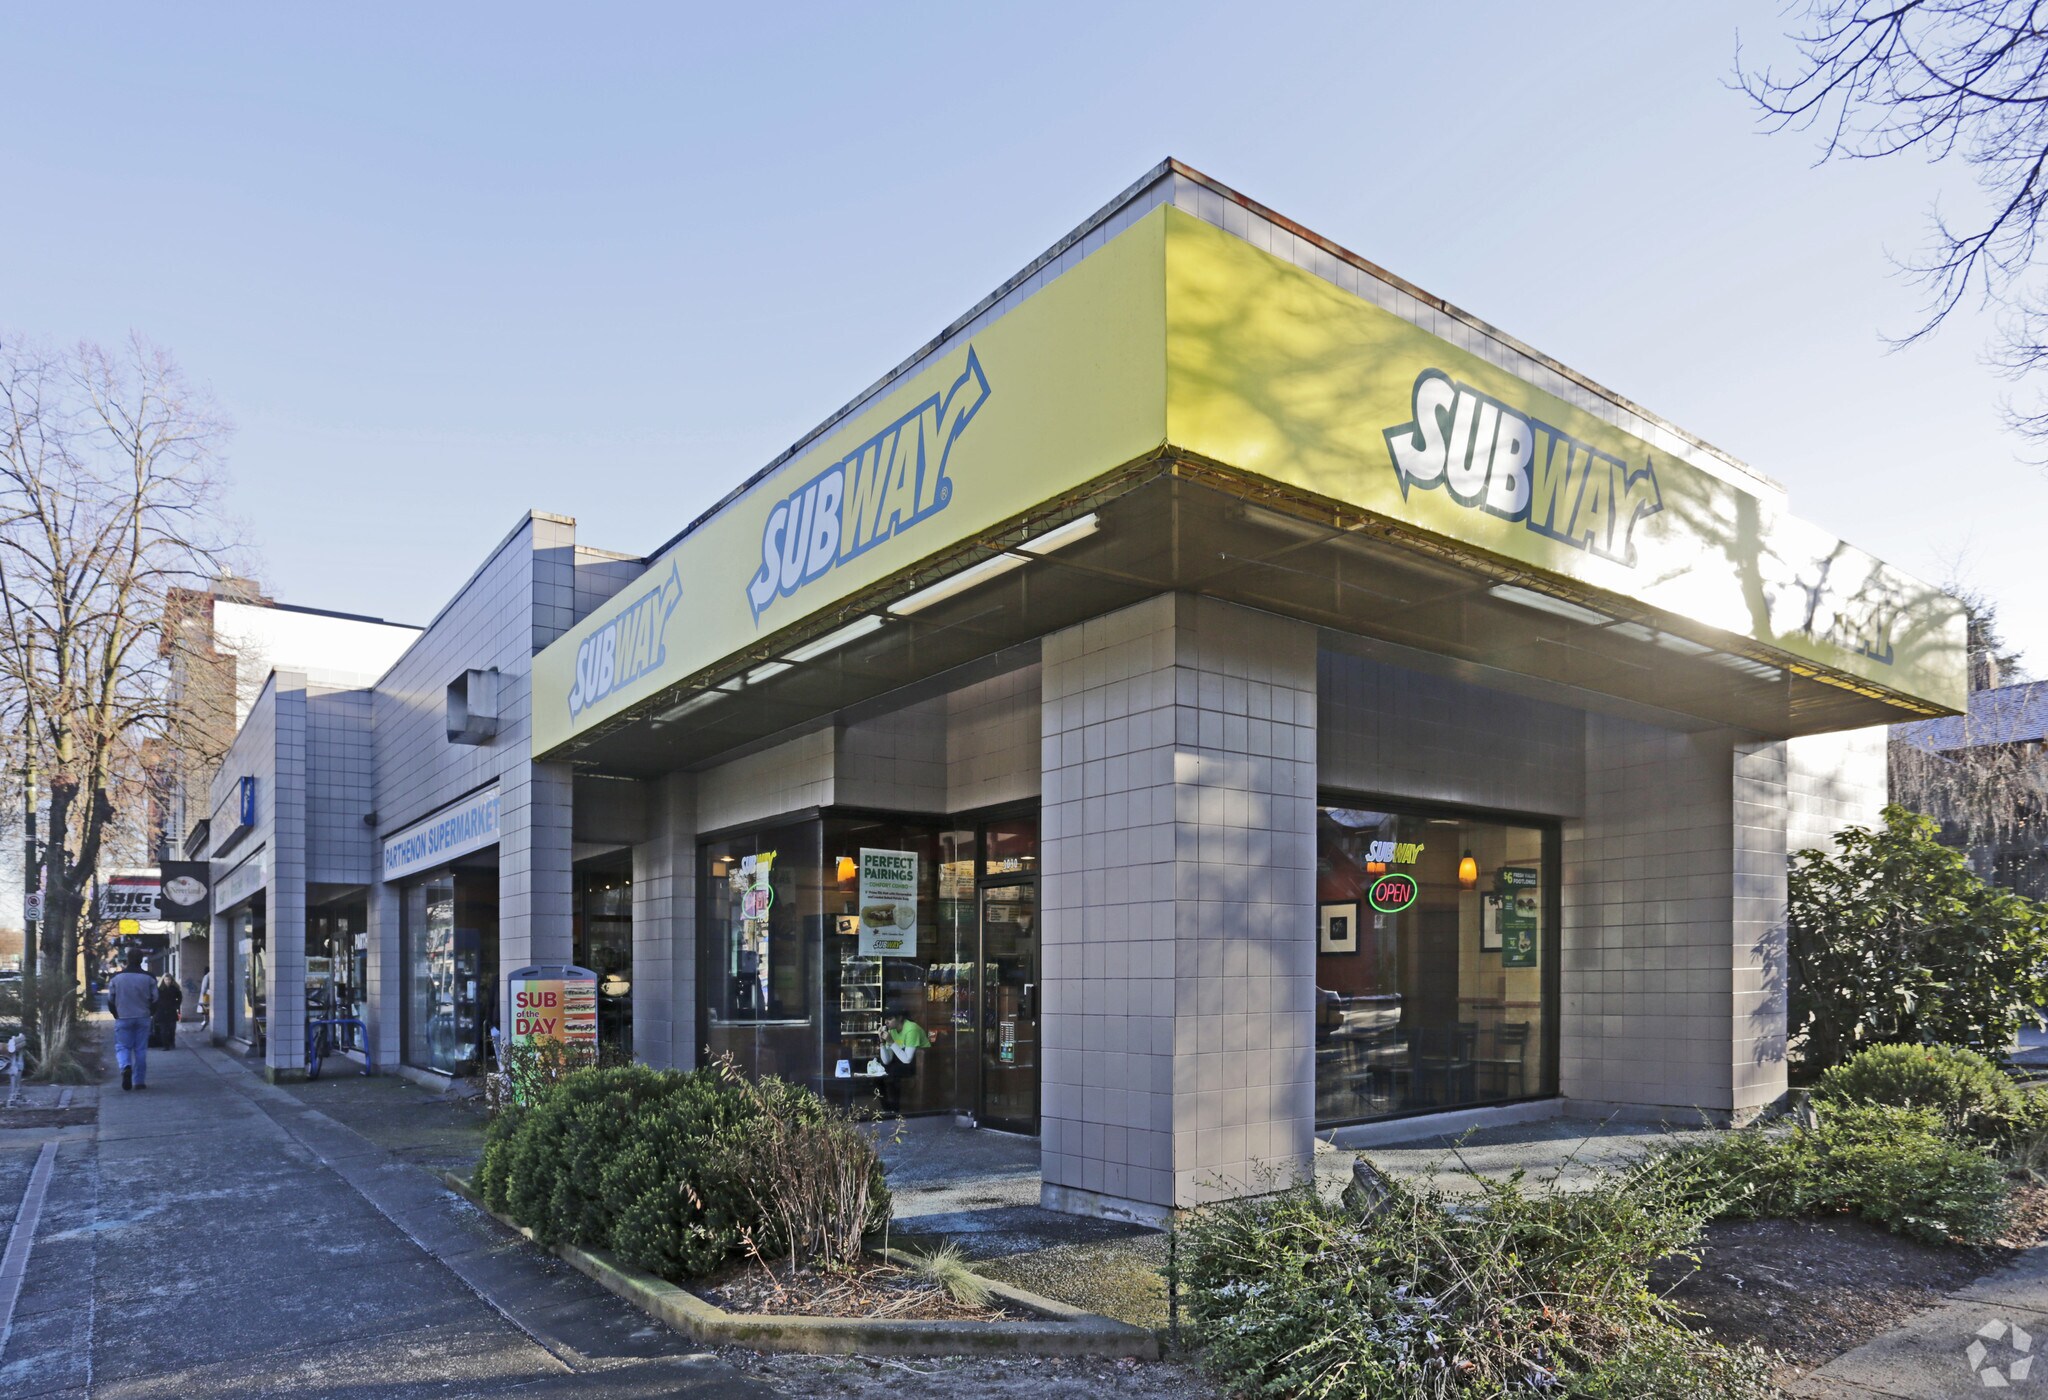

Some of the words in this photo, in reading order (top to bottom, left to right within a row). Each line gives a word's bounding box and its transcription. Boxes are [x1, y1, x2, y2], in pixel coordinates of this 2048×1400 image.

[1382, 367, 1664, 569] SUBWAY
[746, 343, 991, 630] SUBWAY
[568, 558, 683, 727] SUBWAY
[385, 831, 427, 871] PARTHENON
[428, 797, 500, 854] SUPERMARKET
[1365, 840, 1425, 865] SUBWAY
[864, 855, 914, 869] PERFECT
[864, 868, 913, 881] PAIRINGS
[108, 892, 152, 905] BIG
[1376, 883, 1411, 902] OPEN
[106, 905, 151, 913] TIRES
[873, 939, 904, 950] SUBWAY
[516, 991, 557, 1008] SUB
[516, 1010, 525, 1018] of
[526, 1010, 540, 1018] the
[516, 1018, 557, 1035] DAY
